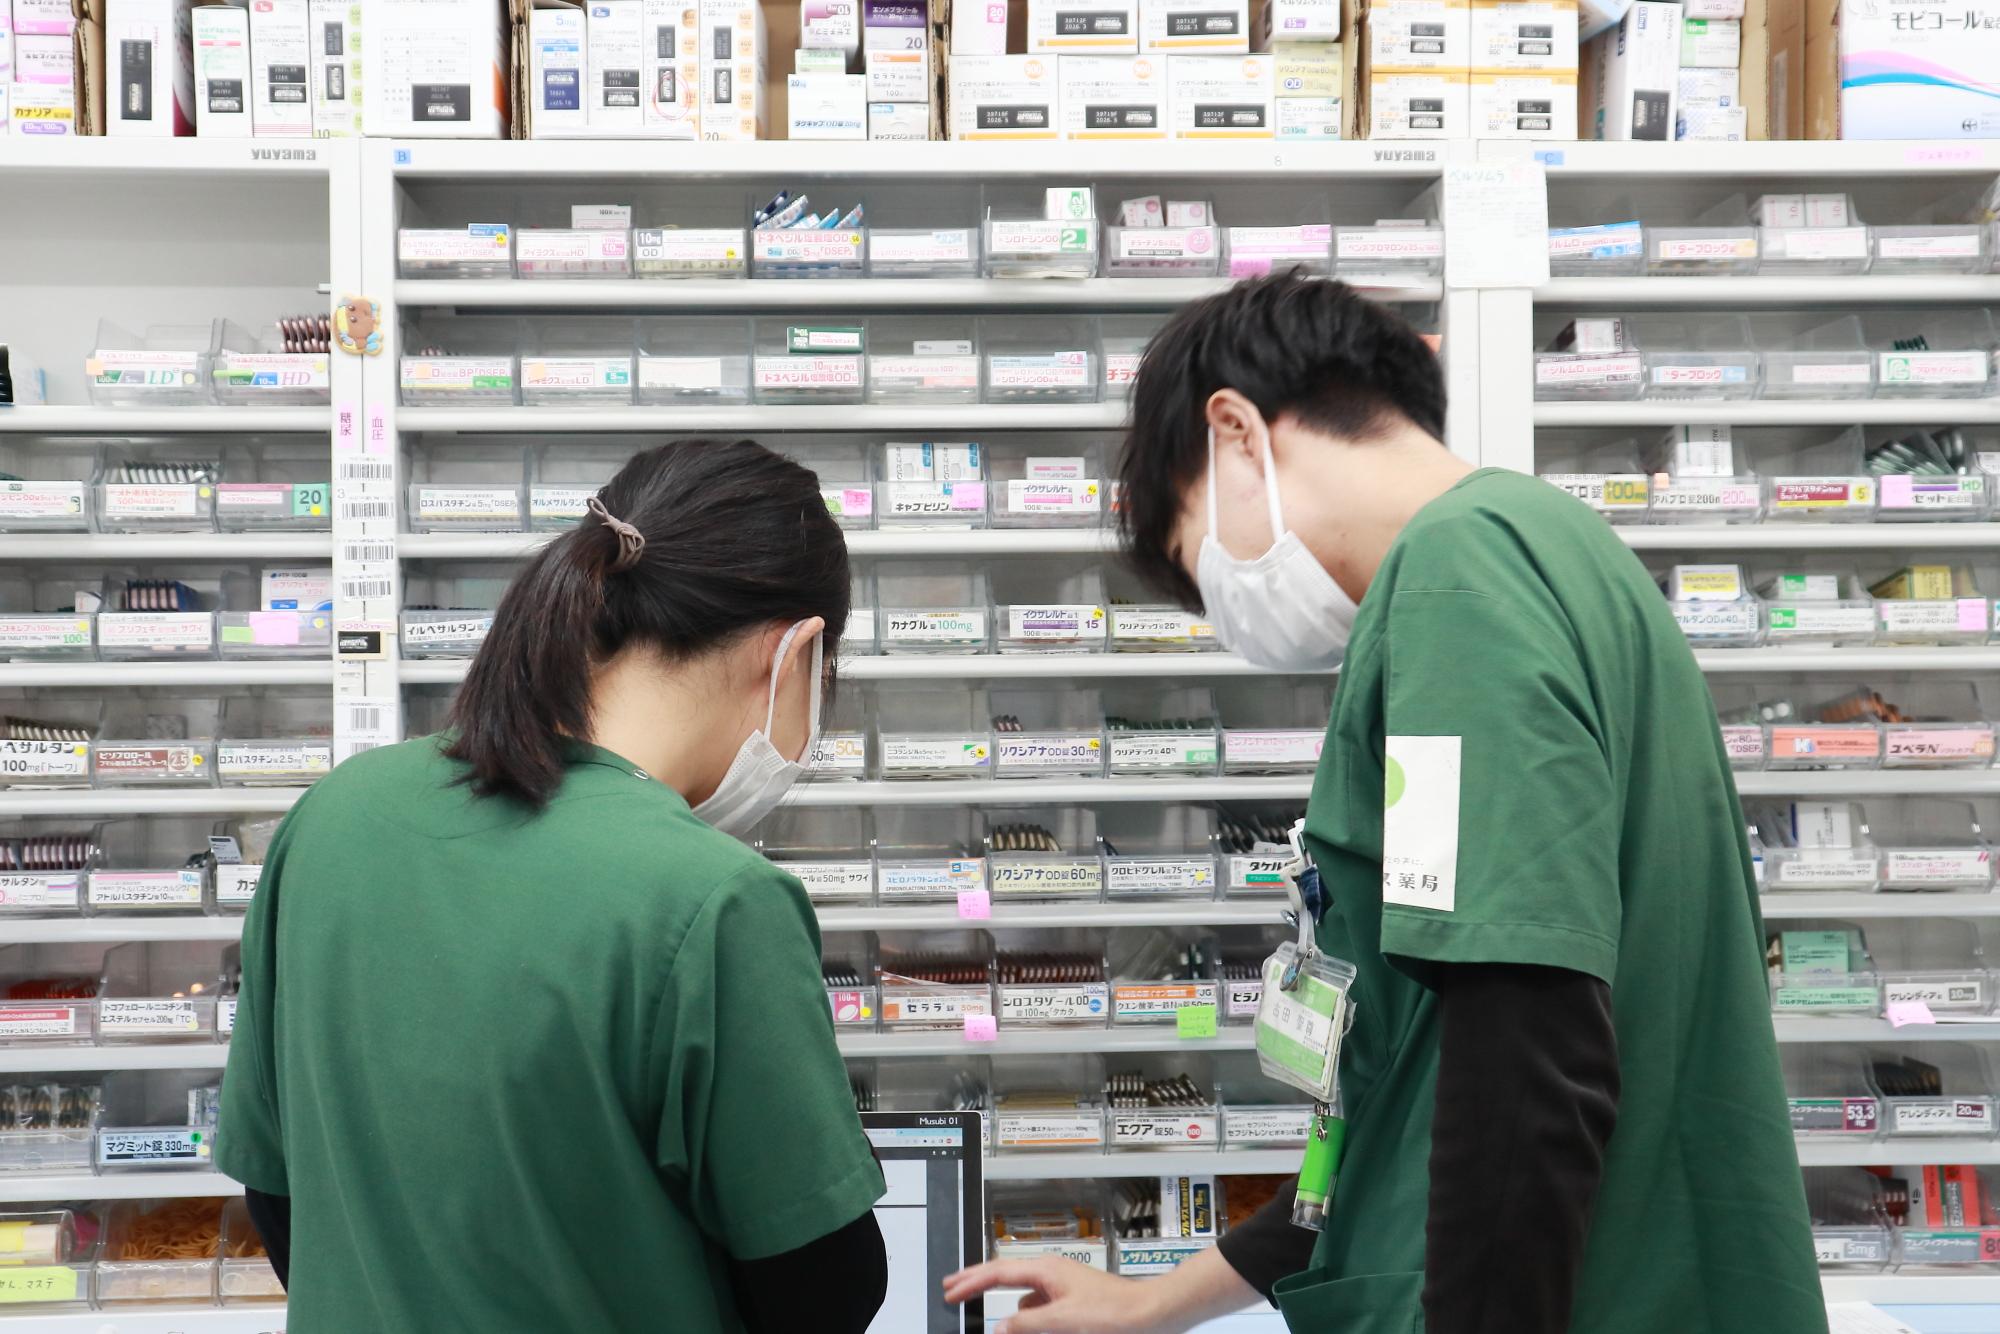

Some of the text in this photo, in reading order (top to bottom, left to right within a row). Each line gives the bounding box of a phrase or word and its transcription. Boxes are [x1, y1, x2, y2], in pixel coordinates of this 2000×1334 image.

[1890, 10, 1978, 30] モビコール
[904, 36, 923, 50] 20
[251, 148, 316, 161] yuyama
[396, 151, 407, 163] B
[1374, 150, 1436, 162] yuyama
[1544, 152, 1555, 164] C
[639, 233, 662, 246] 10mg
[642, 248, 658, 257] OD
[281, 371, 312, 386] HD
[1962, 477, 1981, 492] HD
[299, 490, 322, 504] 20
[1079, 495, 1093, 504] 10
[1085, 619, 1099, 629] 15
[1000, 745, 1100, 758] リクシアナOD錠30mg
[2, 759, 78, 773] 100mg「トーワ」
[994, 867, 1102, 882] リクシアナOD錠60mg
[1950, 988, 1975, 1000] 10mg
[1846, 1105, 1875, 1120] 53.3
[1957, 1105, 1984, 1118] 20mg
[919, 1117, 946, 1125] Musubi
[106, 1139, 197, 1153] マグミット錠 330mg
[1847, 1244, 1876, 1259] 5mg
